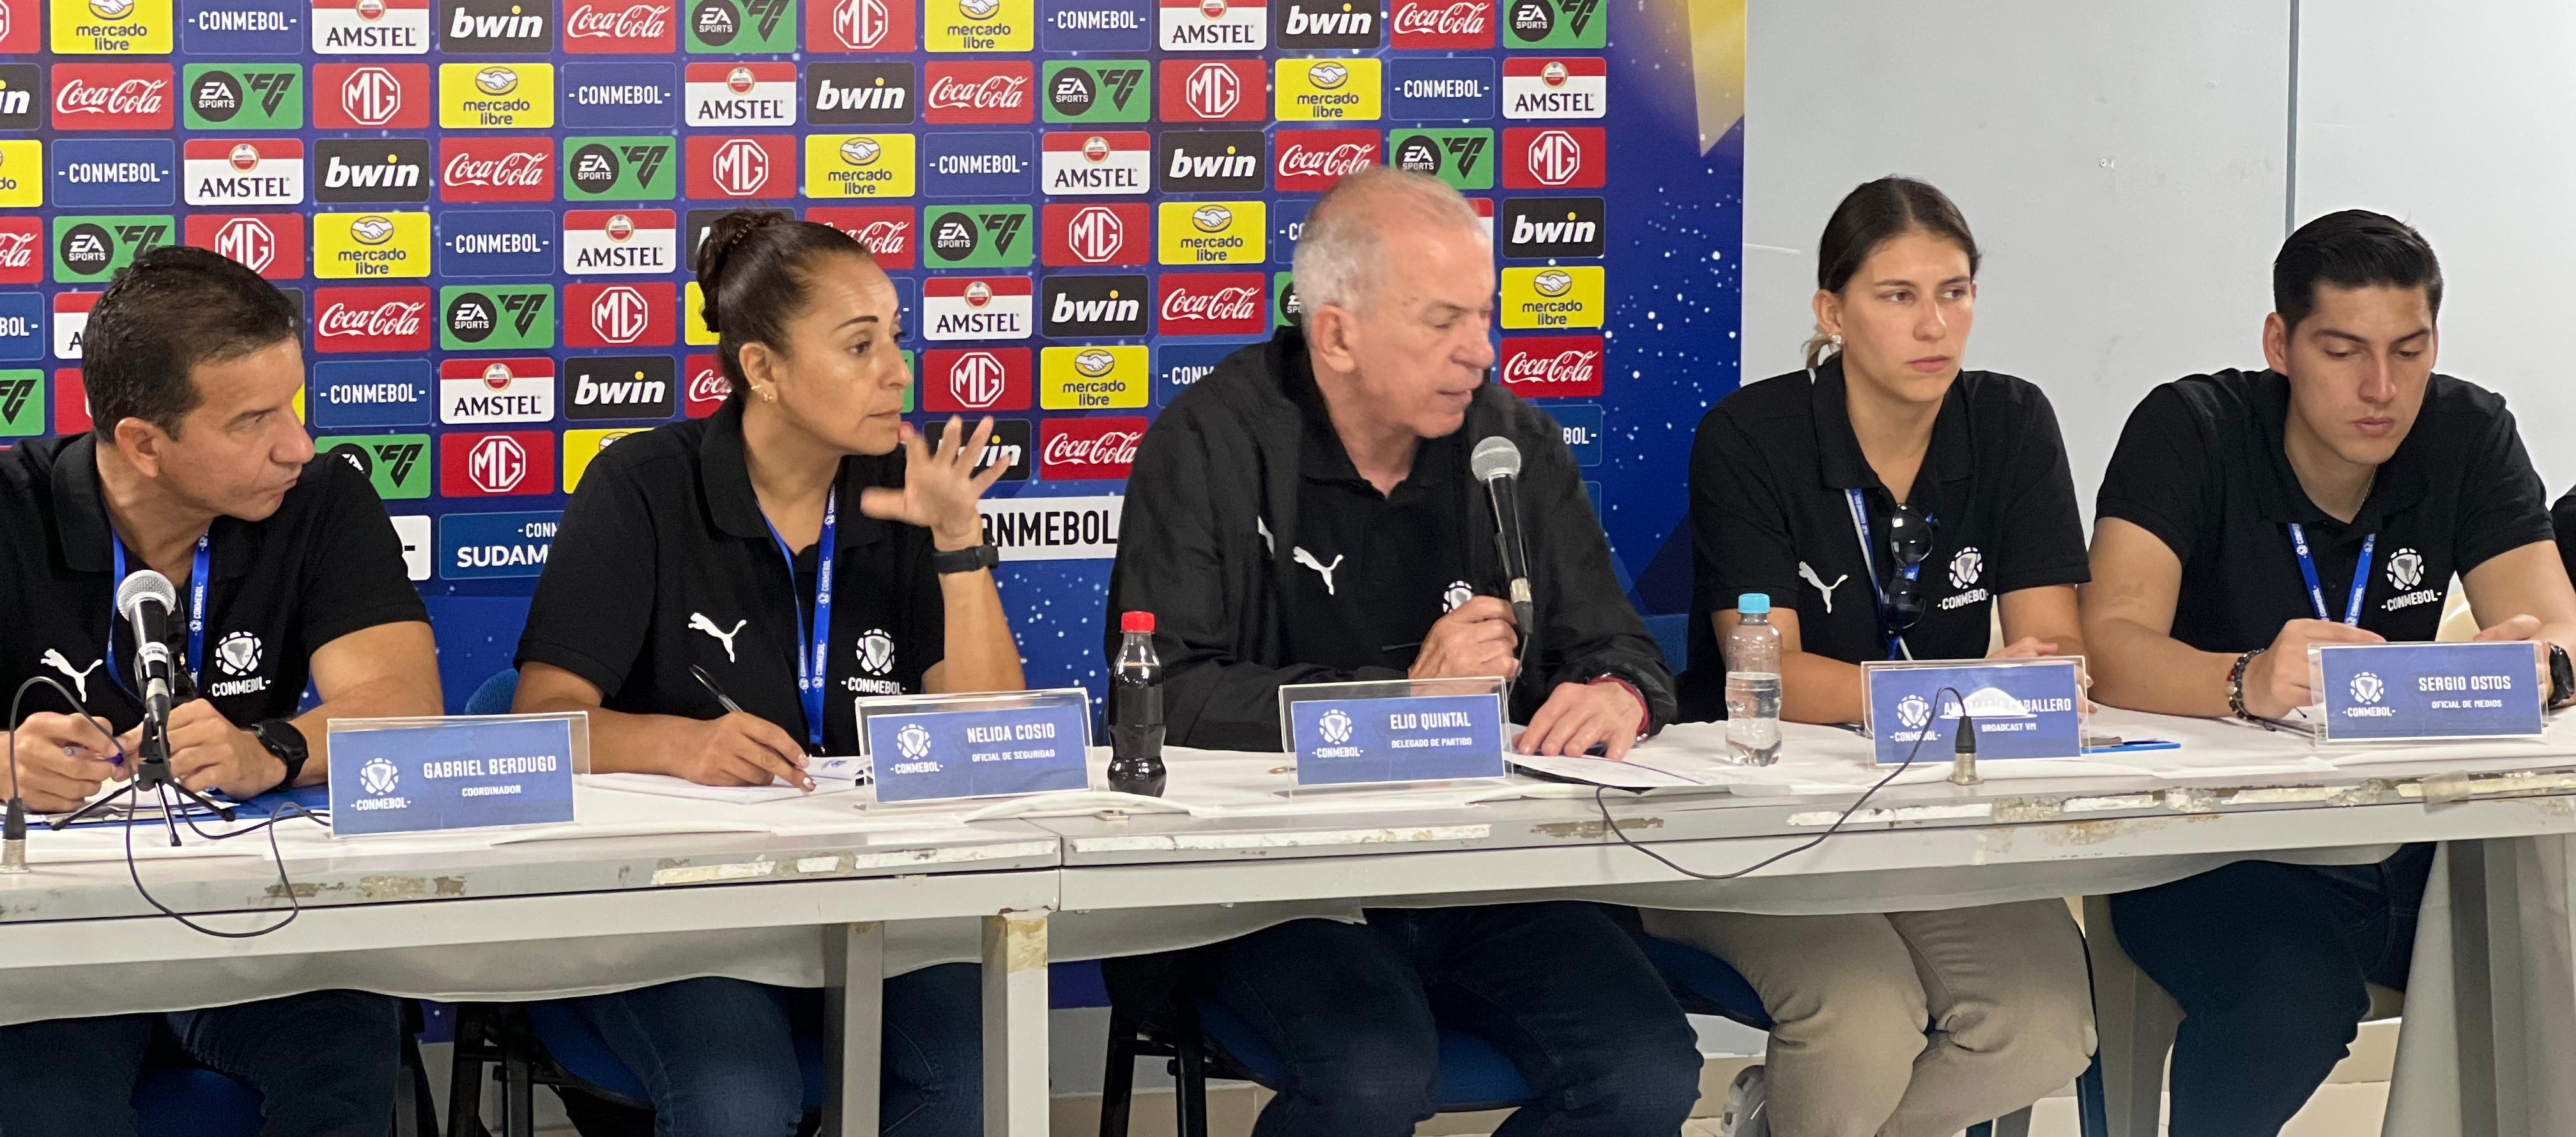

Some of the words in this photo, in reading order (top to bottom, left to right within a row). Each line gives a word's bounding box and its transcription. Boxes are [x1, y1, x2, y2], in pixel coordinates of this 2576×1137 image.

[700, 8, 728, 24] EA
[1285, 4, 1372, 35] bwin
[1394, 1, 1491, 34] Coca-Cola
[1517, 5, 1546, 20] EA
[450, 5, 542, 39] bwin
[568, 5, 670, 38] Coca-Cola
[699, 24, 732, 33] SPORTS
[838, 0, 883, 44] MG
[947, 23, 1011, 36] mercado
[1516, 20, 1547, 29] SPORTS
[76, 24, 147, 36] mercado
[326, 27, 416, 47] AMSTEL
[1172, 26, 1254, 43] AMSTEL
[95, 38, 129, 50] libre
[963, 36, 994, 49] libre
[200, 82, 233, 99] EA
[929, 76, 1028, 109] Coca-Cola
[1057, 77, 1085, 93] EA
[1190, 68, 1236, 113] MG
[57, 79, 169, 114] Coca-Cola
[347, 73, 395, 119] MG
[816, 77, 905, 110] bwin
[1056, 94, 1088, 103] SPORTS
[1297, 92, 1359, 105] mercado
[199, 99, 234, 109] SPORTS
[463, 99, 530, 112] mercado
[699, 100, 783, 120] AMSTEL
[1515, 93, 1595, 112] AMSTEL
[480, 112, 512, 125] libre
[1313, 105, 1343, 118] libre
[1170, 146, 1255, 178] bwin
[1278, 144, 1376, 176] Coca-Cola
[1403, 146, 1433, 162] EA
[1533, 136, 1575, 181] MG
[445, 153, 549, 186] Coca-Cola
[579, 155, 608, 171] EA
[717, 144, 764, 190] MG
[1402, 162, 1434, 171] SPORTS
[325, 155, 419, 188] bwin
[578, 171, 611, 180] SPORTS
[828, 169, 892, 181] mercado
[1055, 169, 1137, 188] AMSTEL
[199, 178, 289, 197] AMSTEL
[844, 182, 875, 195] libre
[940, 223, 969, 239] EA
[1073, 212, 1118, 259] MG
[1512, 211, 1595, 244] bwin
[70, 235, 102, 251] EA
[220, 224, 269, 271] MG
[938, 239, 970, 248] SPORTS
[1181, 236, 1243, 248] mercado
[69, 252, 105, 262] SPORTS
[338, 248, 406, 261] mercado
[577, 247, 663, 267] AMSTEL
[1197, 248, 1227, 261] libre
[356, 261, 388, 275] libre
[457, 304, 487, 319] EA
[1052, 291, 1138, 323] bwin
[1162, 287, 1260, 321] Coca-Cola
[1522, 300, 1582, 312] mercado
[319, 301, 425, 337] Coca-Cola
[596, 293, 643, 338] MG
[936, 314, 1019, 333] AMSTEL
[1538, 312, 1567, 325] libre
[455, 320, 489, 329] SPORTS
[1504, 349, 1598, 383] Coca-Cola
[575, 371, 664, 405] bwin
[955, 358, 1000, 402] MG
[1063, 380, 1126, 393] mercado
[454, 395, 540, 416] AMSTEL
[1078, 393, 1109, 406] libre
[1045, 432, 1143, 464] Coca-Cola
[473, 441, 521, 487] MG
[2419, 676, 2465, 692] SERGIO
[2471, 676, 2511, 690] OSTOS
[2474, 699, 2502, 708] MEDIOS
[1390, 714, 1416, 729] ELIO
[1420, 712, 1471, 730] QUINTAL
[1982, 724, 2024, 732] BROADCAST
[967, 725, 1012, 743] NELIDA
[1016, 723, 1055, 741] COSIO
[1392, 738, 1429, 749] DELEGADO
[1430, 738, 1440, 747] DE
[1442, 737, 1472, 747] PARTIDO
[972, 751, 1000, 762] OFICIAL
[1002, 751, 1012, 760] DE
[1015, 749, 1055, 759] SEGURIDAD
[424, 759, 485, 779] GABRIEL
[489, 756, 556, 775] BERDUGO
[462, 785, 521, 797] COORDINADOR
